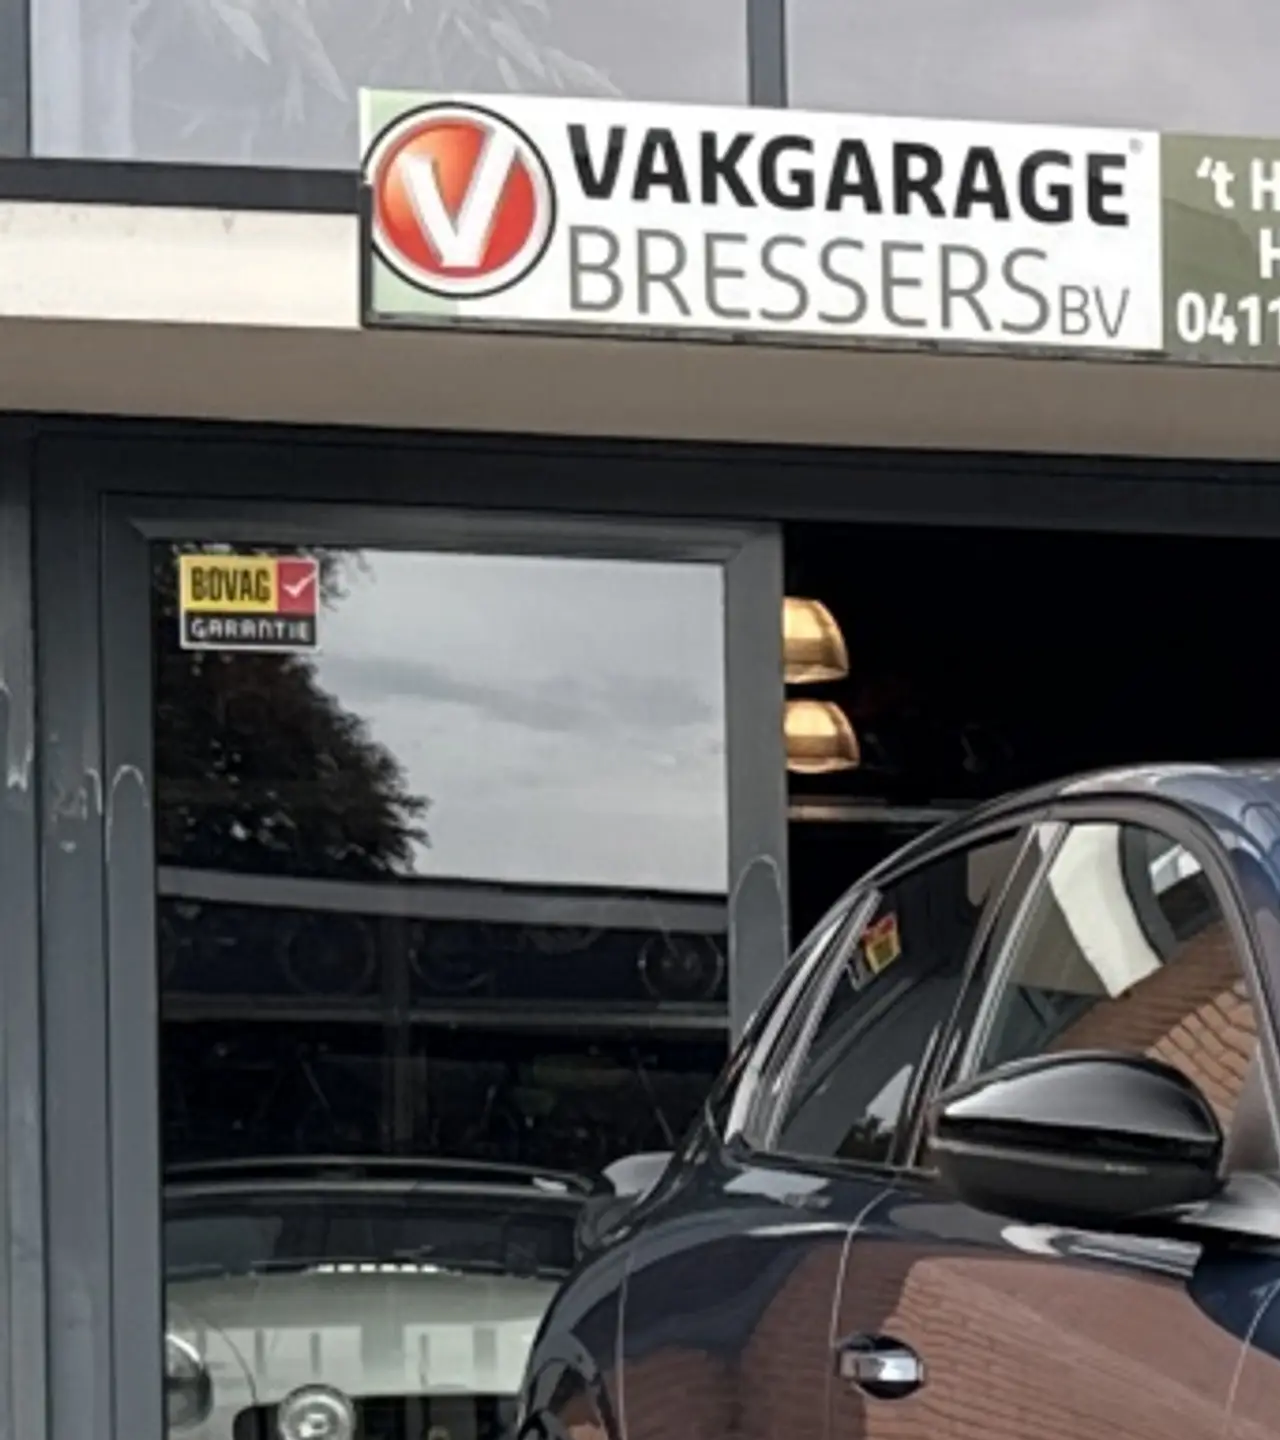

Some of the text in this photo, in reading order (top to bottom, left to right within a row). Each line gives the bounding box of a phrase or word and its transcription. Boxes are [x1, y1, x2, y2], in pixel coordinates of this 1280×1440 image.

[567, 122, 1130, 227] VAKGARAGE
[191, 566, 270, 602] BOVAG
[191, 618, 311, 642] GARANTIE
